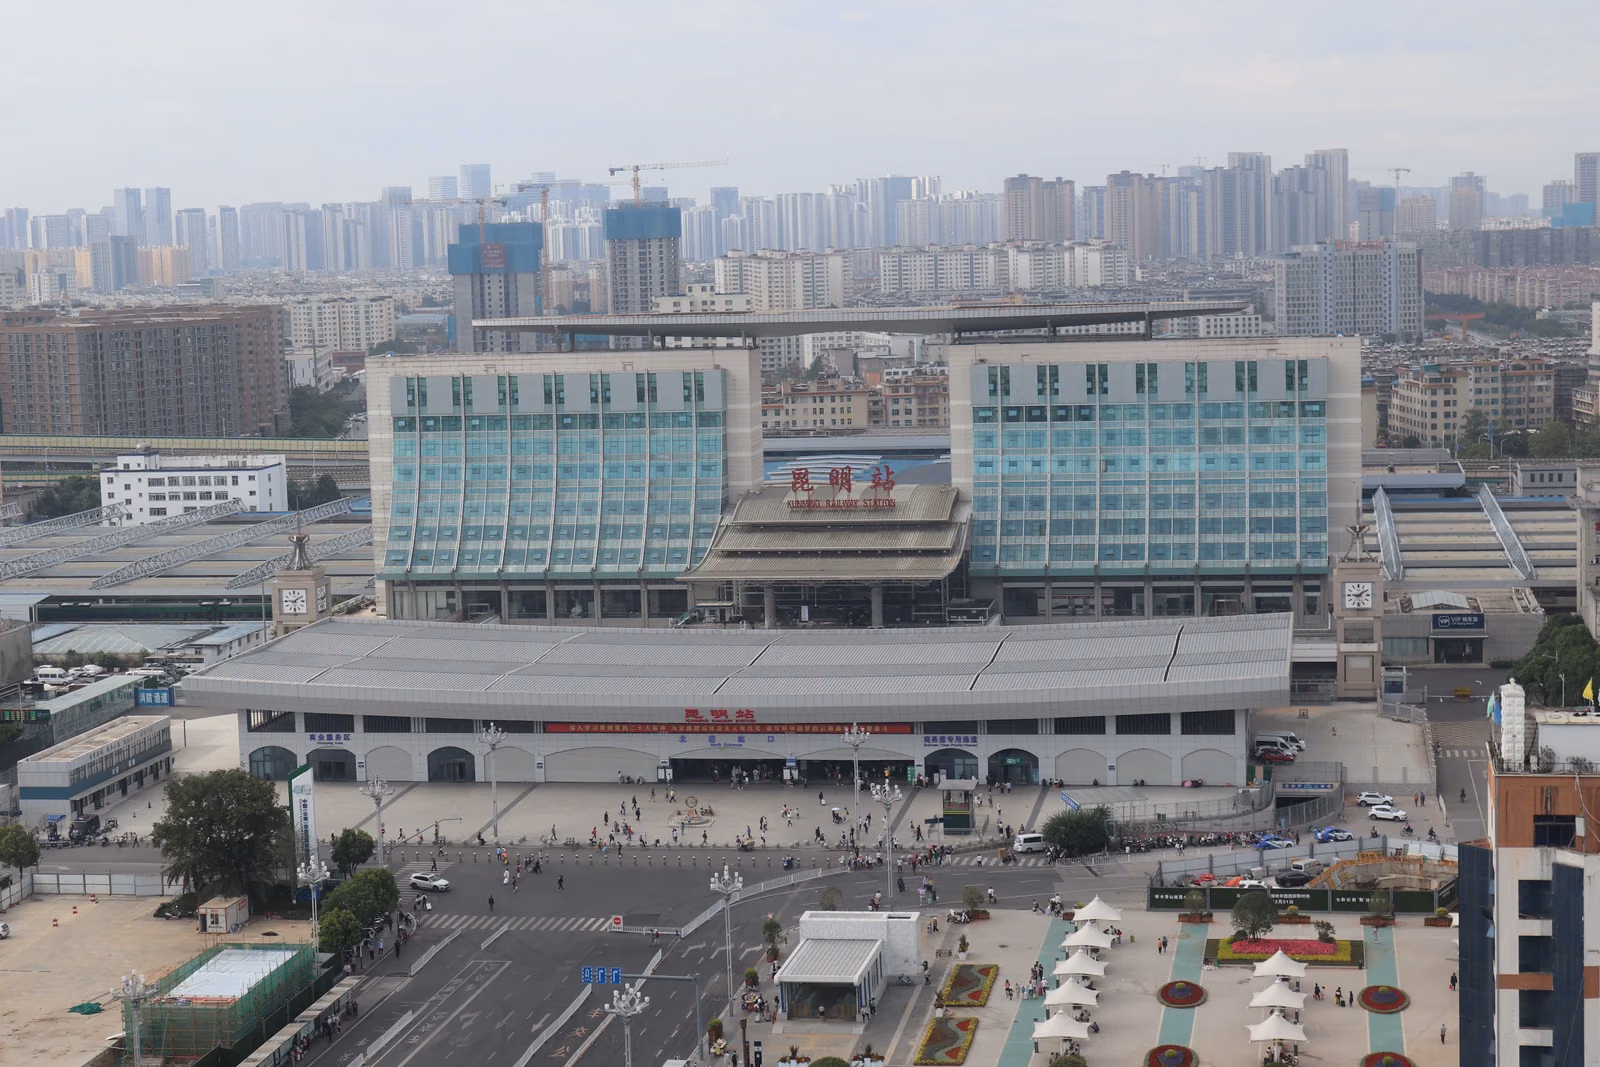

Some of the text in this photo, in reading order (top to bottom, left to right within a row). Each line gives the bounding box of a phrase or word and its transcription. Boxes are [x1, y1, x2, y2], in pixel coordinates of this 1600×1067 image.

[791, 465, 895, 493] 昆明站
[787, 498, 896, 509] KUNMING RAILWAY STATION
[684, 708, 755, 719] 昆明站
